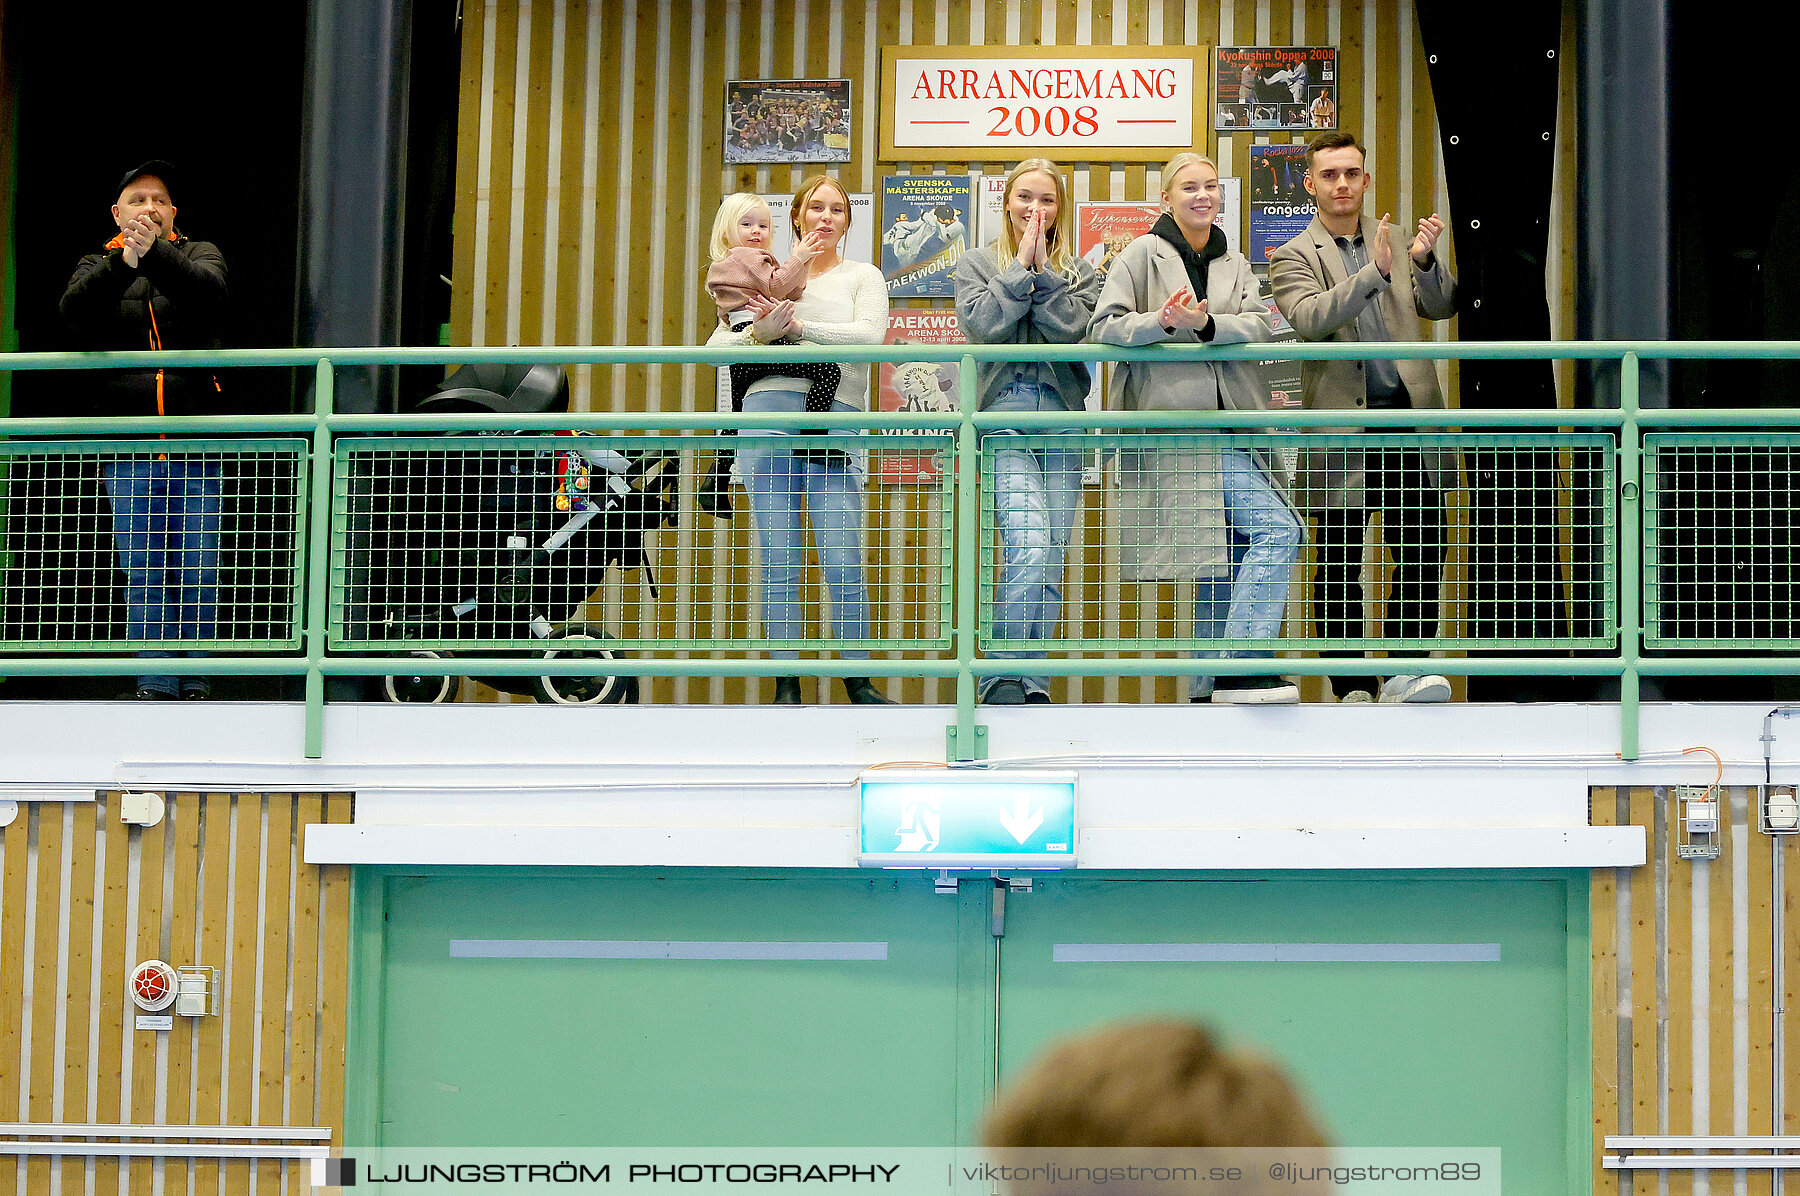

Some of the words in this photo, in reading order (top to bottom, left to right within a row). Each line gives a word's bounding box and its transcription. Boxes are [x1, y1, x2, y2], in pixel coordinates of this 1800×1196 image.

[1218, 50, 1272, 63] Kyokushin
[1310, 49, 1335, 60] 2008
[911, 69, 1177, 100] ARRANGEMANG
[986, 106, 1099, 137] 2008
[904, 179, 952, 187] SVENSKA
[886, 186, 969, 194] MÄSTERSKAPEN
[926, 194, 953, 202] SKÖVDE
[885, 234, 966, 291] TAEKWON-DO
[907, 329, 940, 337] ARENA
